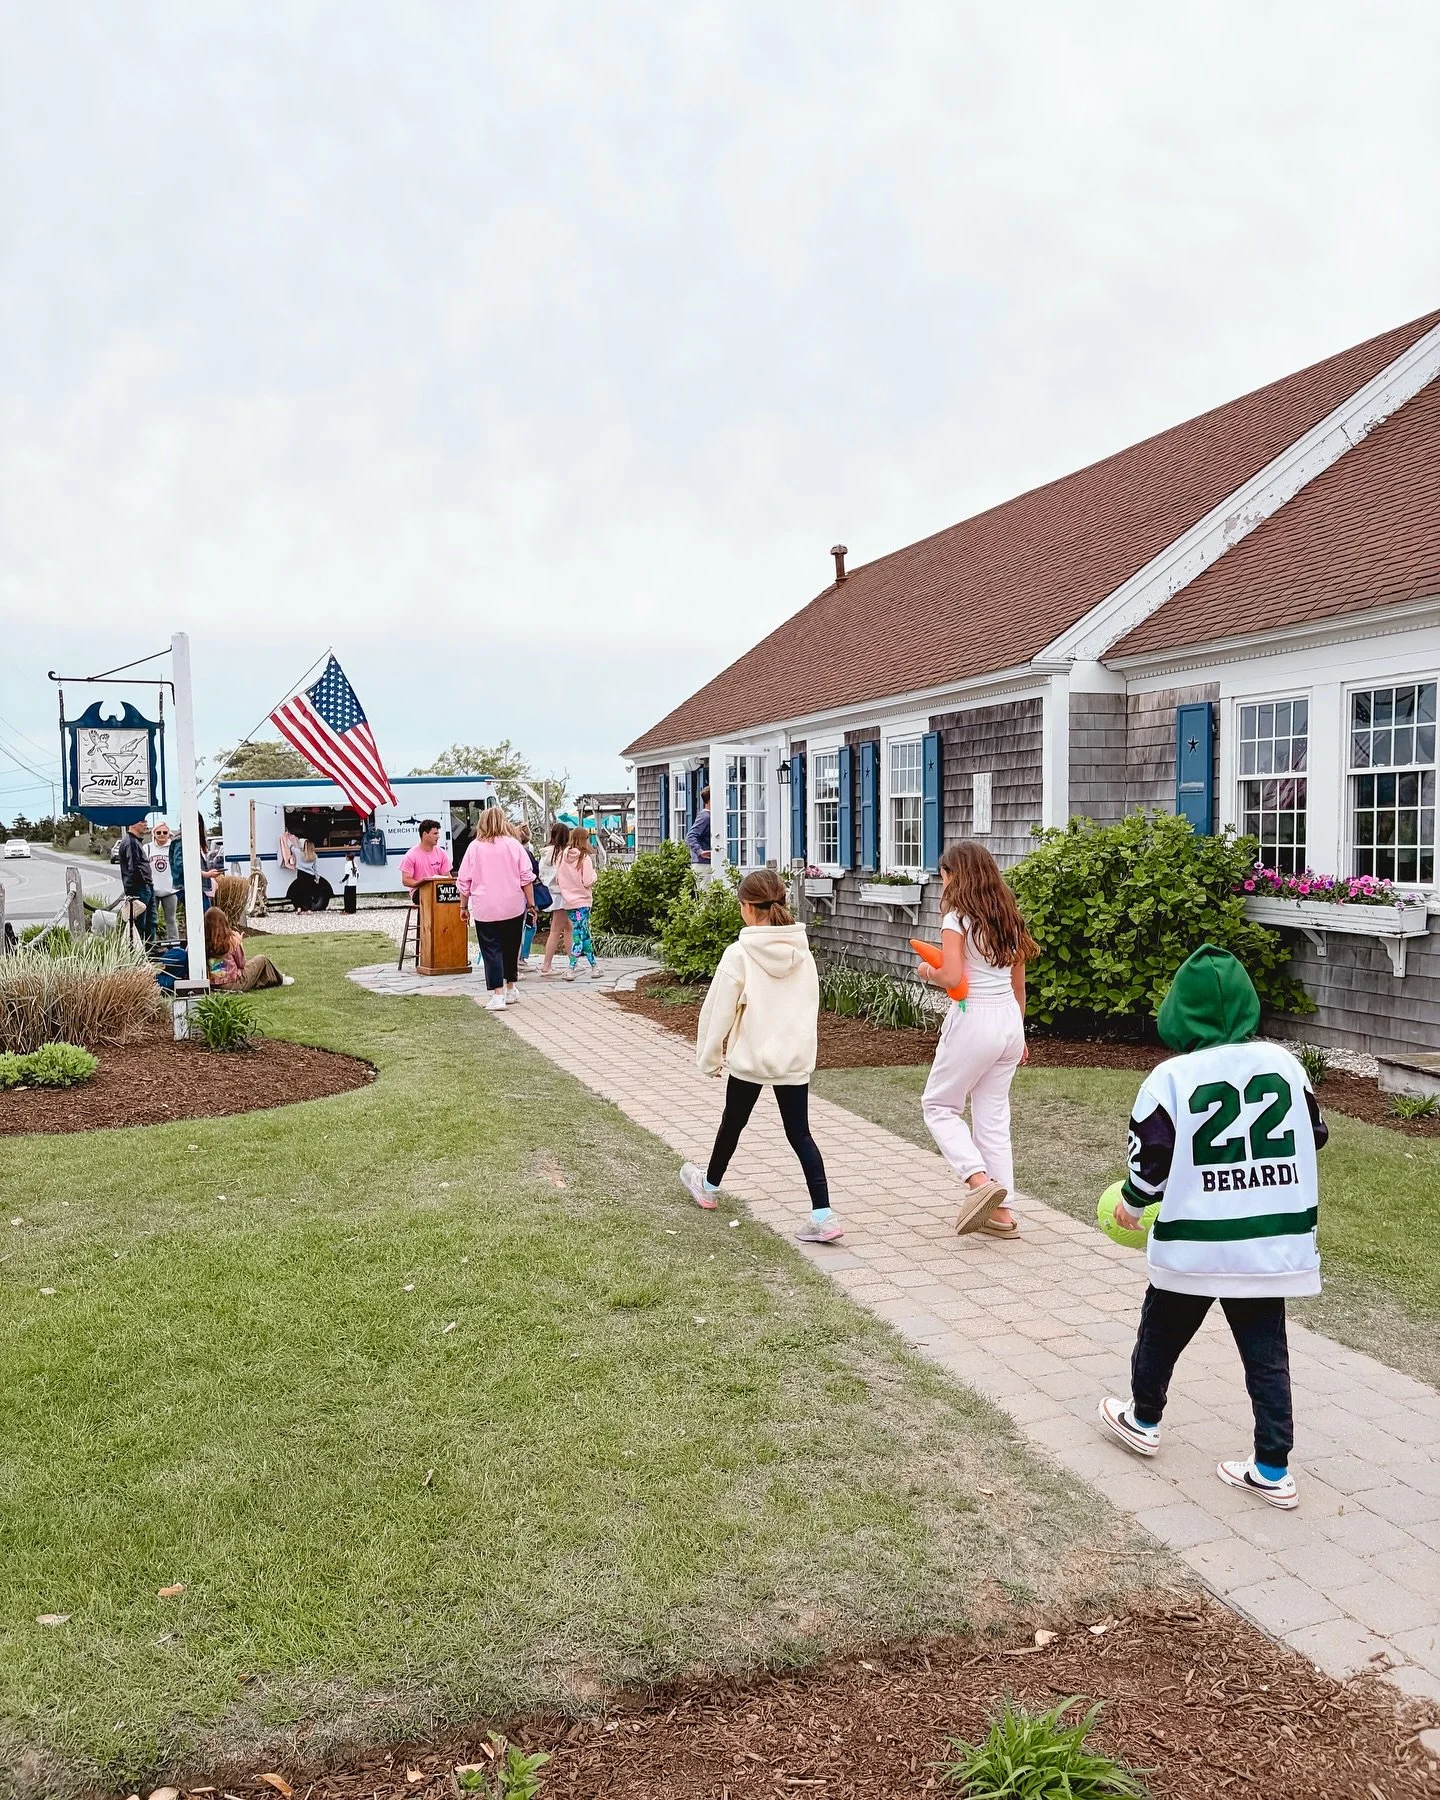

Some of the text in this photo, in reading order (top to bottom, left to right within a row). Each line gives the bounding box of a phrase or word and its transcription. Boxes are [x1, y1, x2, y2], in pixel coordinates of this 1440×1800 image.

[82, 775, 145, 792] Sand Bar
[1188, 1072, 1296, 1166] 22
[1201, 1162, 1299, 1193] BERARDI
